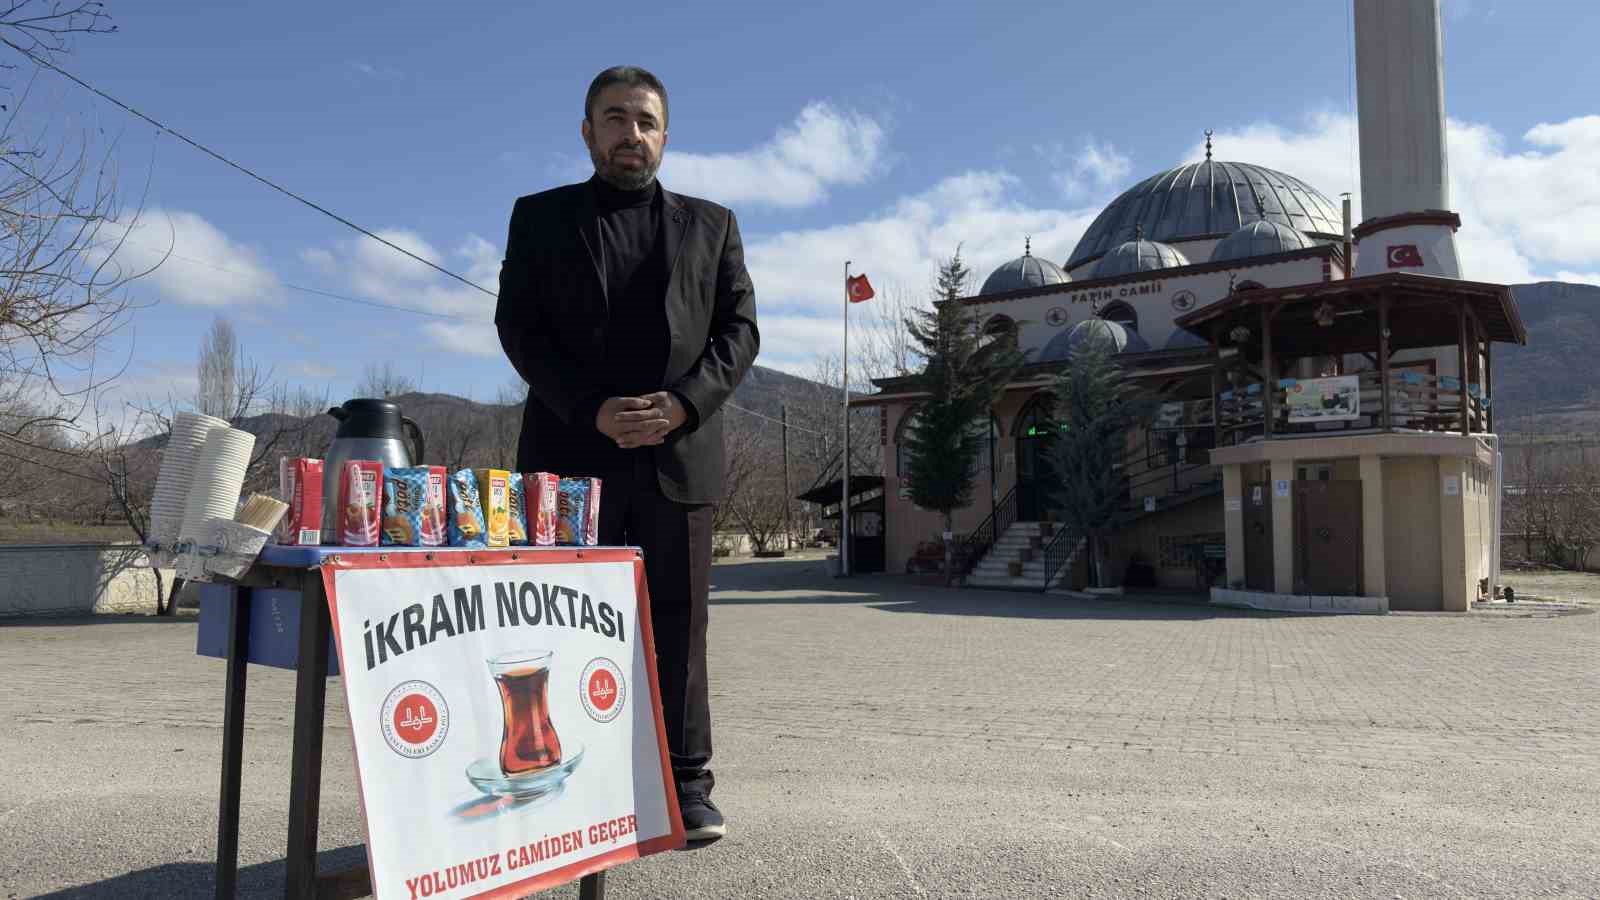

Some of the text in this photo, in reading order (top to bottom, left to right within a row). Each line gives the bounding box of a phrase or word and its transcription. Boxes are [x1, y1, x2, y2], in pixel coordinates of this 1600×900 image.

[362, 584, 487, 671] İKRAM
[494, 581, 626, 643] NOKTASI
[405, 814, 639, 900] YOLUMUZ CAMİDEN GEÇER
